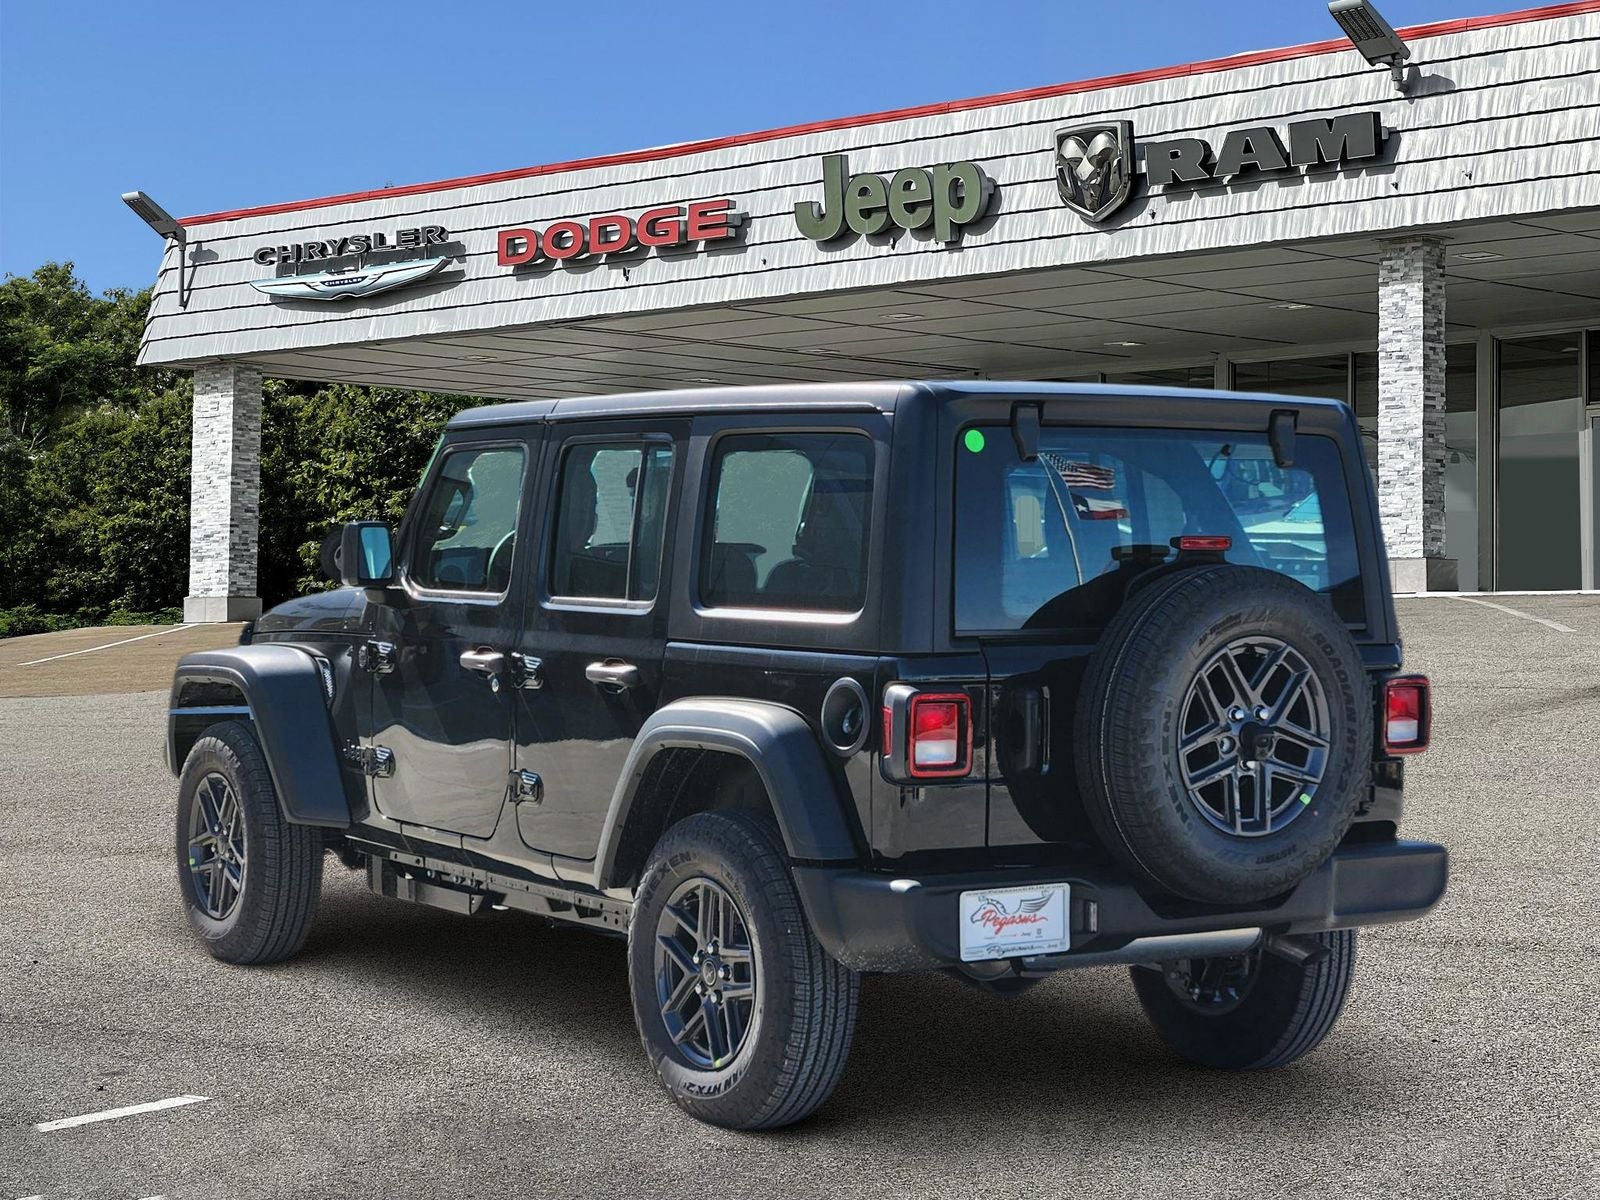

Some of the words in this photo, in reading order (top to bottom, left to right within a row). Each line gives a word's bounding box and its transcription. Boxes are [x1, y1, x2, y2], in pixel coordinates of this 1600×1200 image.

[1146, 111, 1382, 187] RAM
[497, 199, 736, 266] DODGE
[795, 154, 989, 242] Jeep
[253, 225, 450, 266] CHRYSLER
[1162, 712, 1189, 824] NEXEN
[981, 909, 1048, 935] Pegasus
